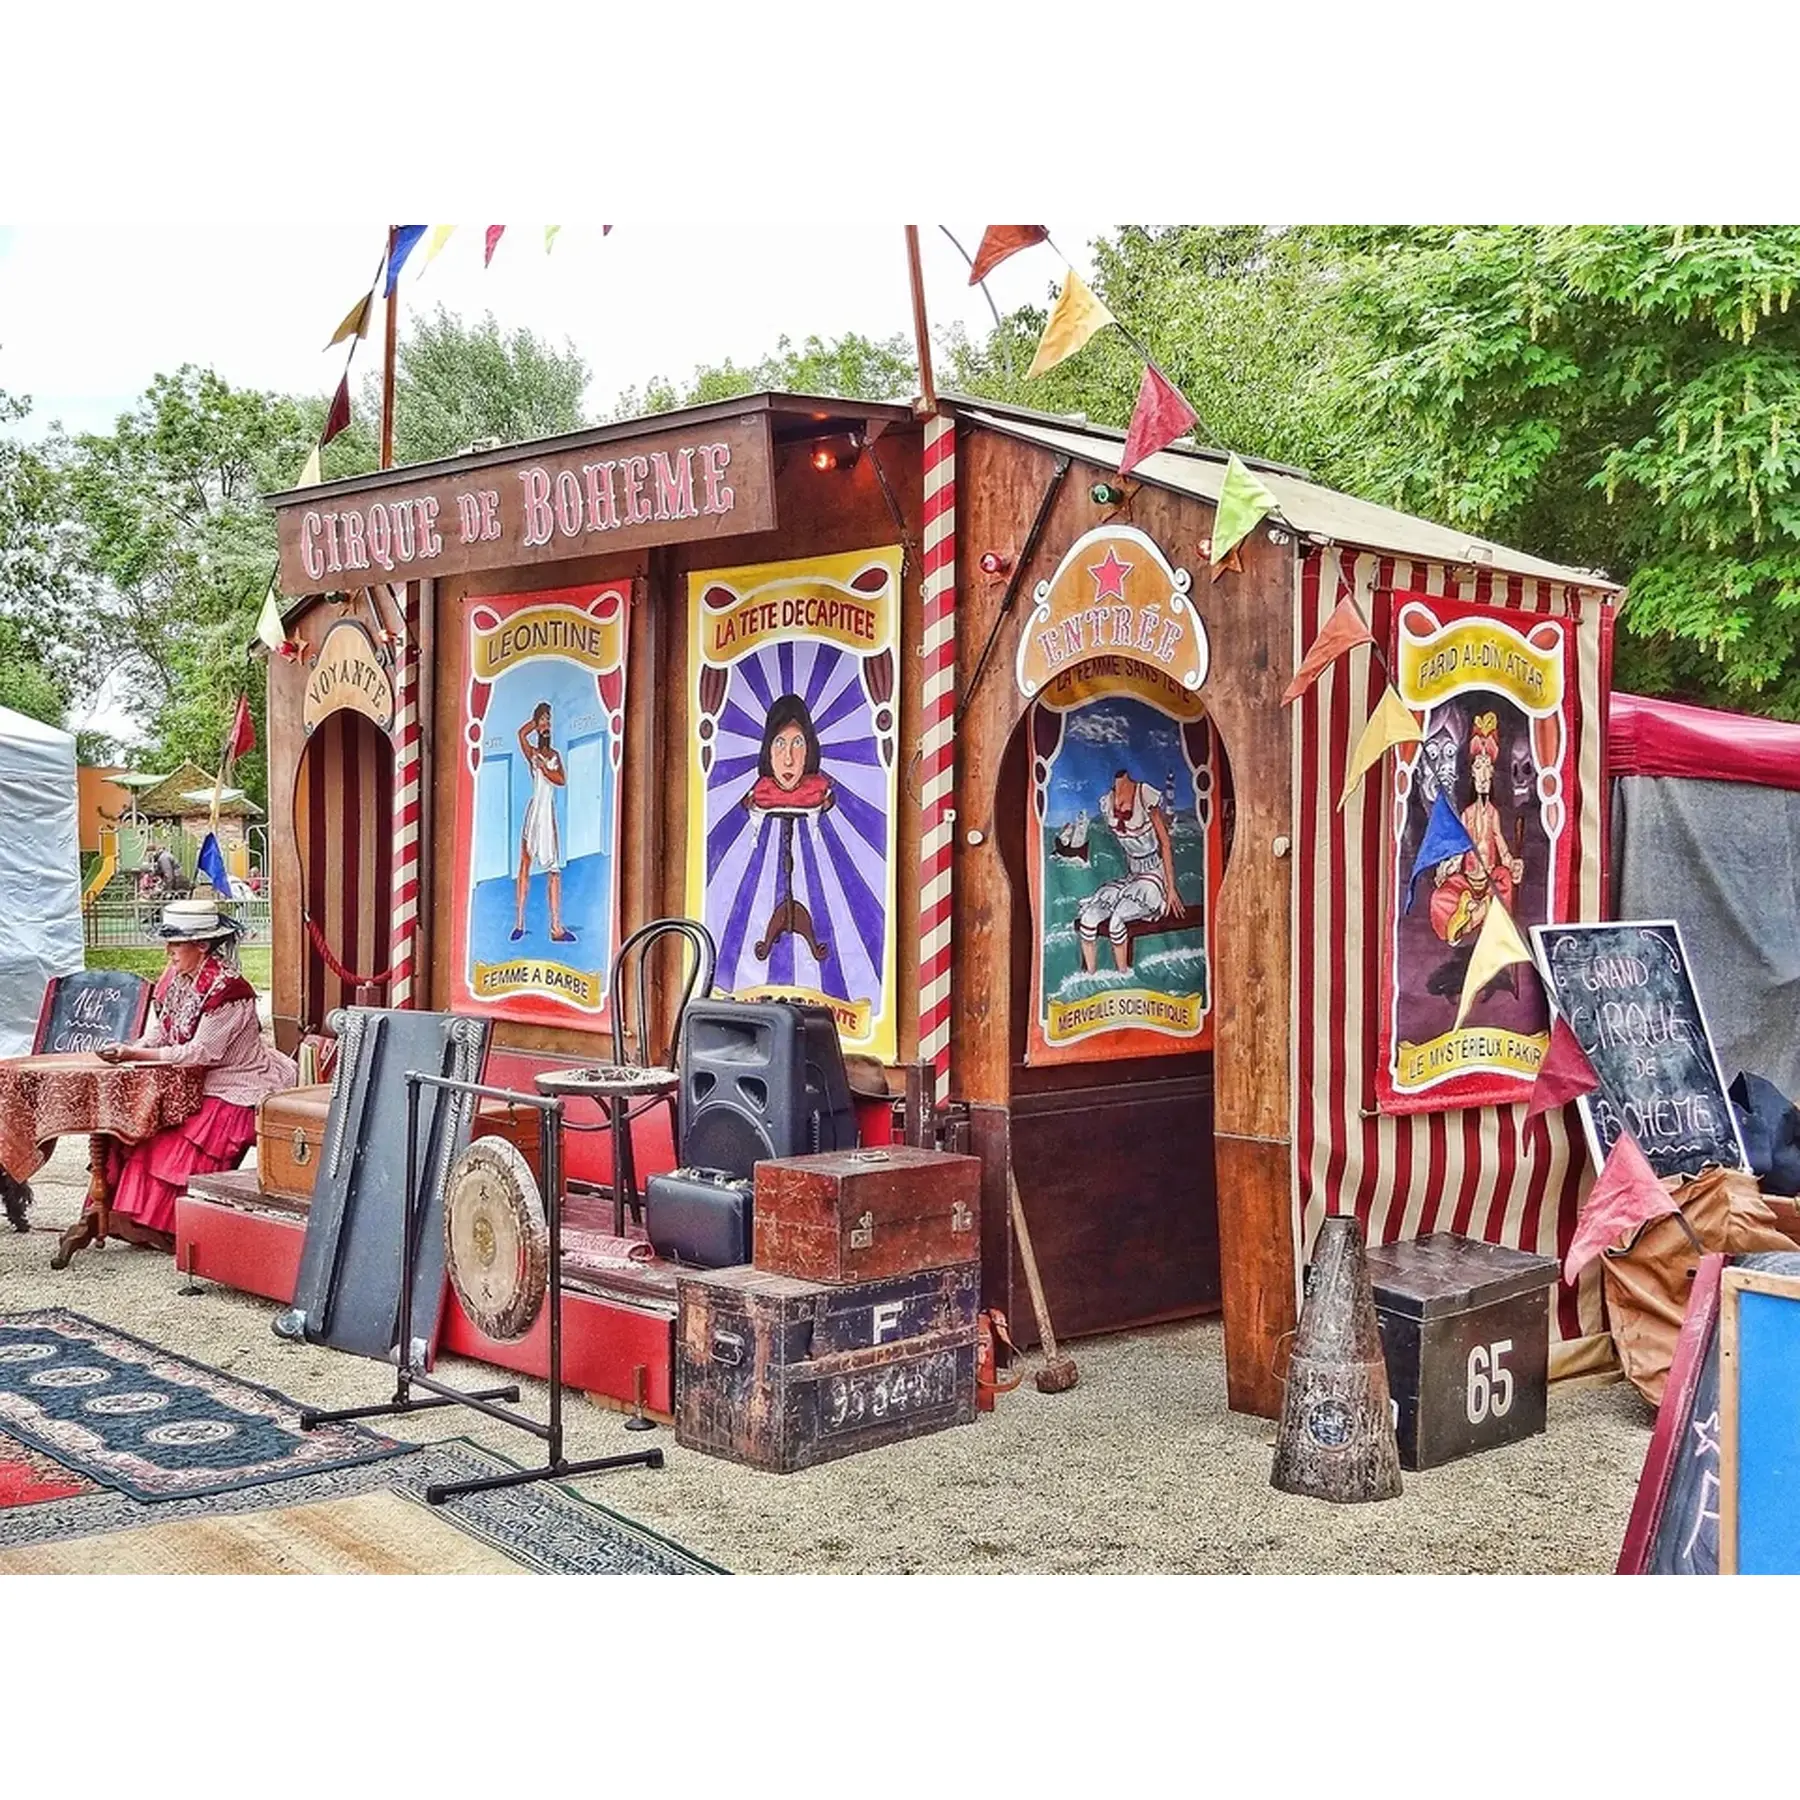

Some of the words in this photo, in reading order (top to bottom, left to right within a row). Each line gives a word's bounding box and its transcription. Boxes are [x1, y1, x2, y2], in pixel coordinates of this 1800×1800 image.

[300, 496, 443, 581] CIRQUE
[457, 490, 501, 545] DE
[519, 442, 735, 547] BOHEME
[487, 620, 601, 667] LEONTINE
[716, 618, 737, 650] LA
[739, 601, 778, 637] TETE
[782, 598, 877, 640] DECAPITEE
[1037, 603, 1184, 668] ENTRÉE
[309, 659, 387, 709] VOYANTE
[1056, 668, 1072, 692] LA
[1077, 655, 1120, 682] FEMME
[1419, 648, 1458, 688] FARID
[1505, 653, 1544, 696] ATTAR
[483, 967, 529, 987] FEMME
[532, 968, 542, 984] A
[545, 969, 589, 1000] BARBE
[1582, 956, 1649, 991] GRAND
[1058, 1000, 1116, 1032] MERVEILLE
[1118, 998, 1189, 1026] SCIENTIFIQUE
[1570, 1001, 1690, 1055] CIRQUE
[1409, 1054, 1425, 1079] LE
[1430, 1036, 1503, 1068] MYSTÉRIEUX
[1507, 1039, 1542, 1066] FAKIR
[1636, 1056, 1657, 1080] DE
[873, 1299, 904, 1345] F
[1466, 1339, 1514, 1425] 65
